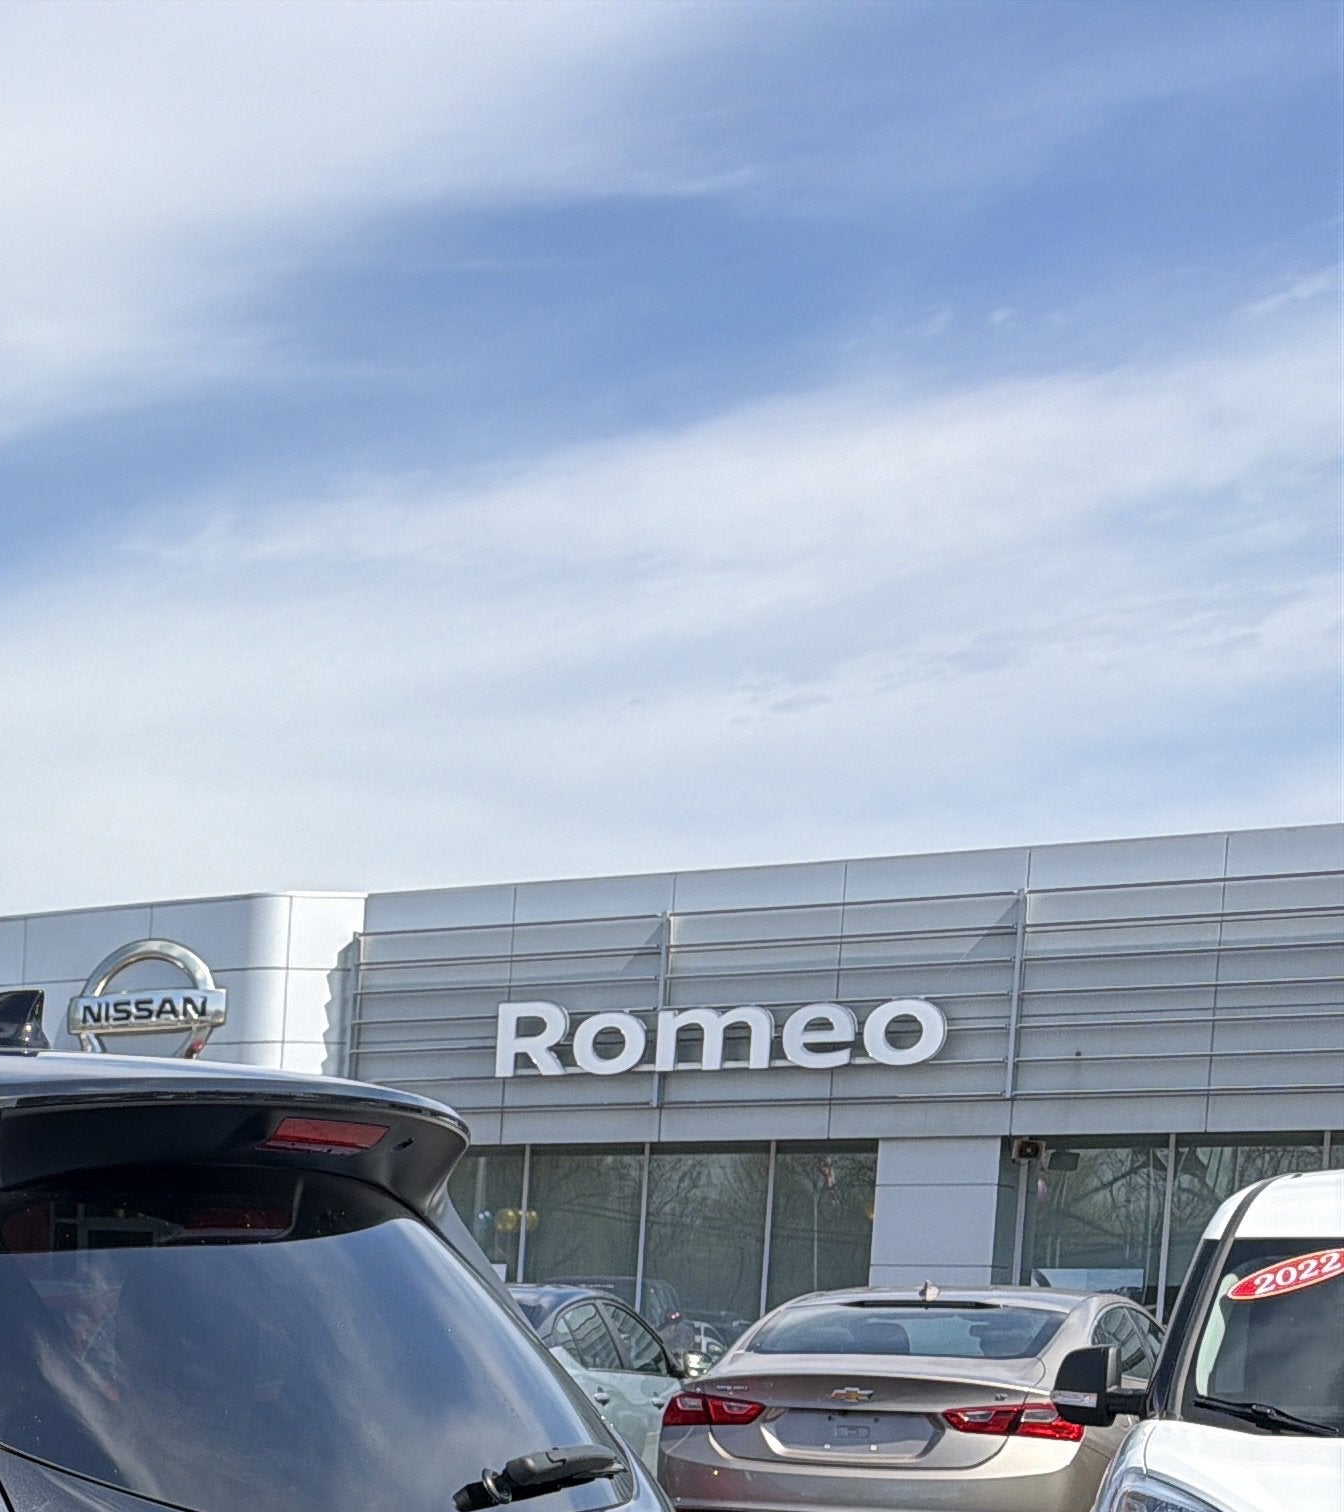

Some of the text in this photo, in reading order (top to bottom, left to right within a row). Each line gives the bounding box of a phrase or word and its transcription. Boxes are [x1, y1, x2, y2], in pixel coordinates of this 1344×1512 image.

[82, 996, 208, 1025] NISSAN
[495, 997, 948, 1078] Romeo
[1254, 1252, 1342, 1295] 2022
